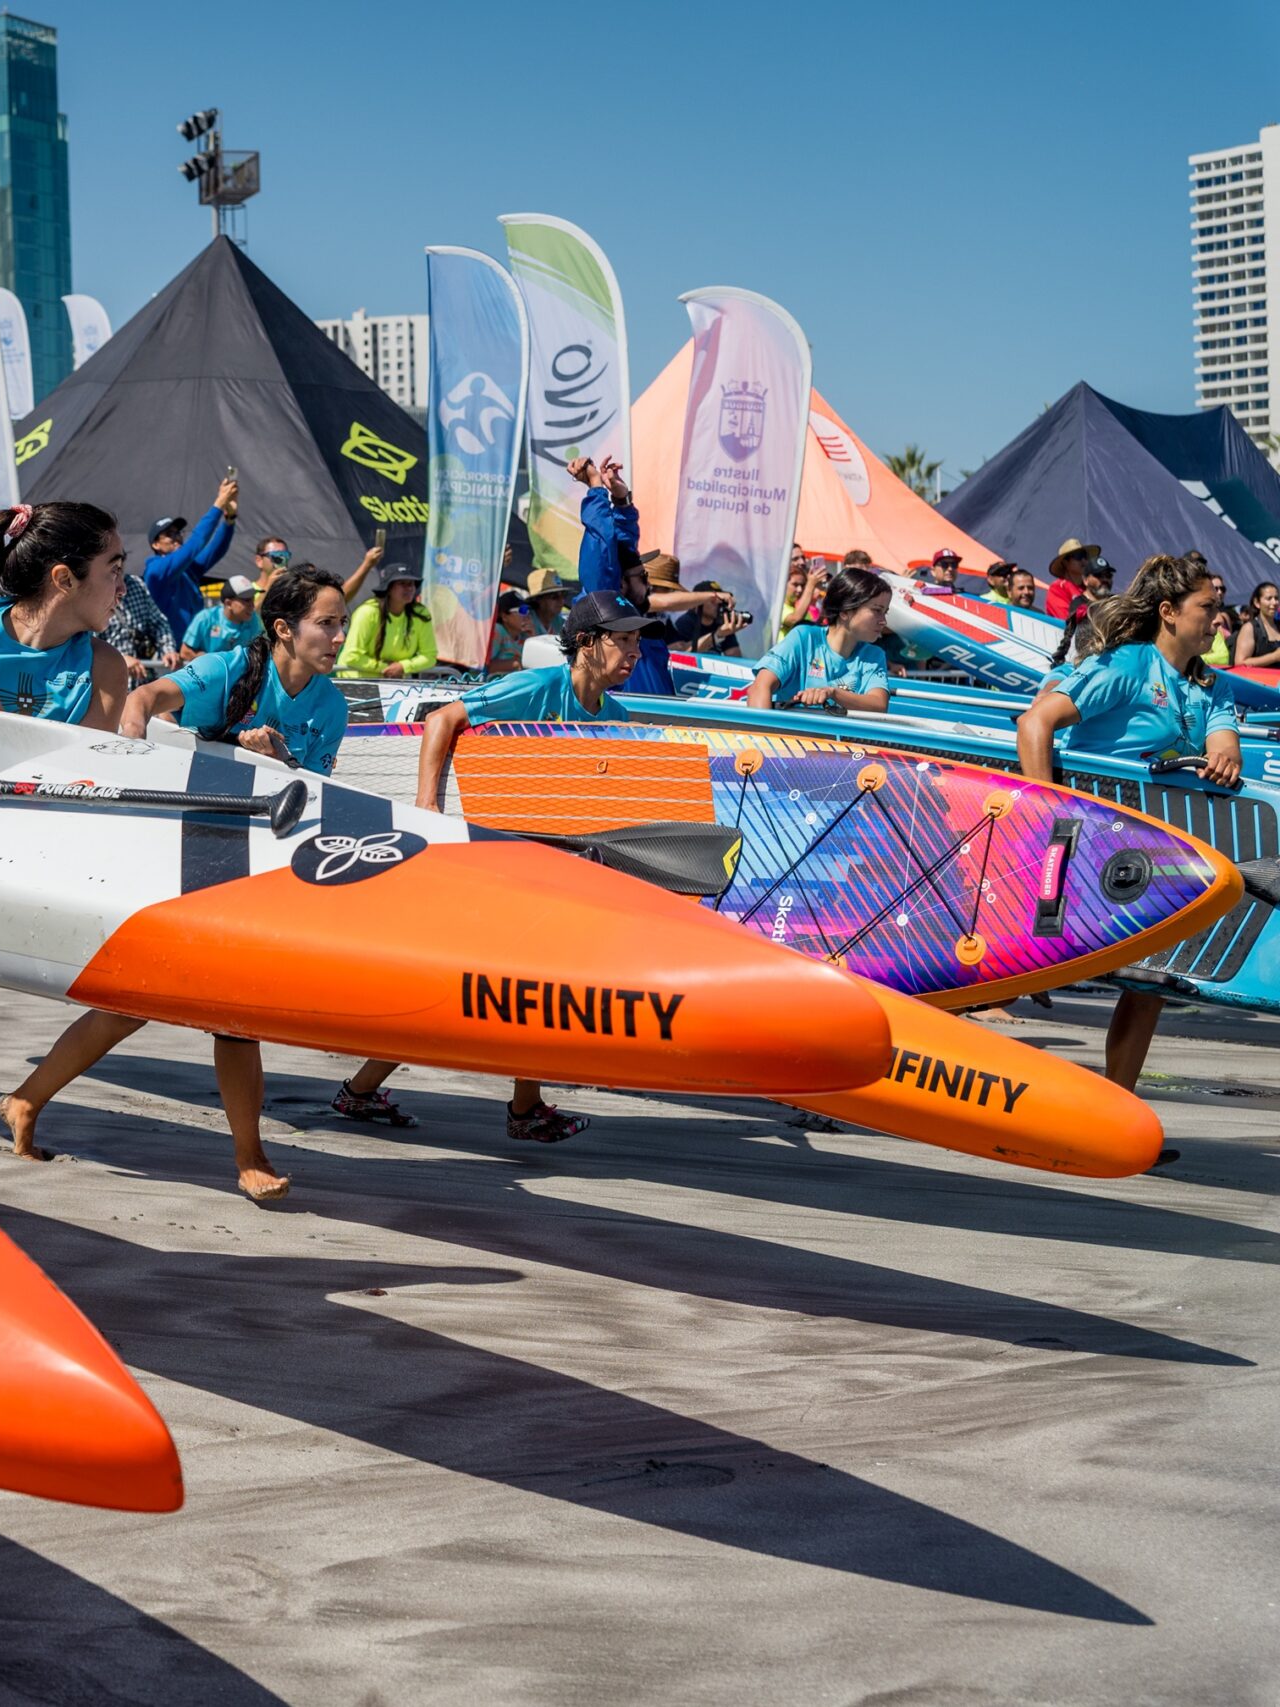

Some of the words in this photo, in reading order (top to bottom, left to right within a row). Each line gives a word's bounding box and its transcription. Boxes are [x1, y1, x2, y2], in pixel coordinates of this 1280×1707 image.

[360, 494, 430, 523] Skati
[36, 783, 83, 796] POWER
[83, 786, 122, 799] BLADE
[1043, 847, 1059, 896] SKATINGER
[462, 971, 685, 1041] INFINITY
[883, 1047, 1029, 1114] FINITY
